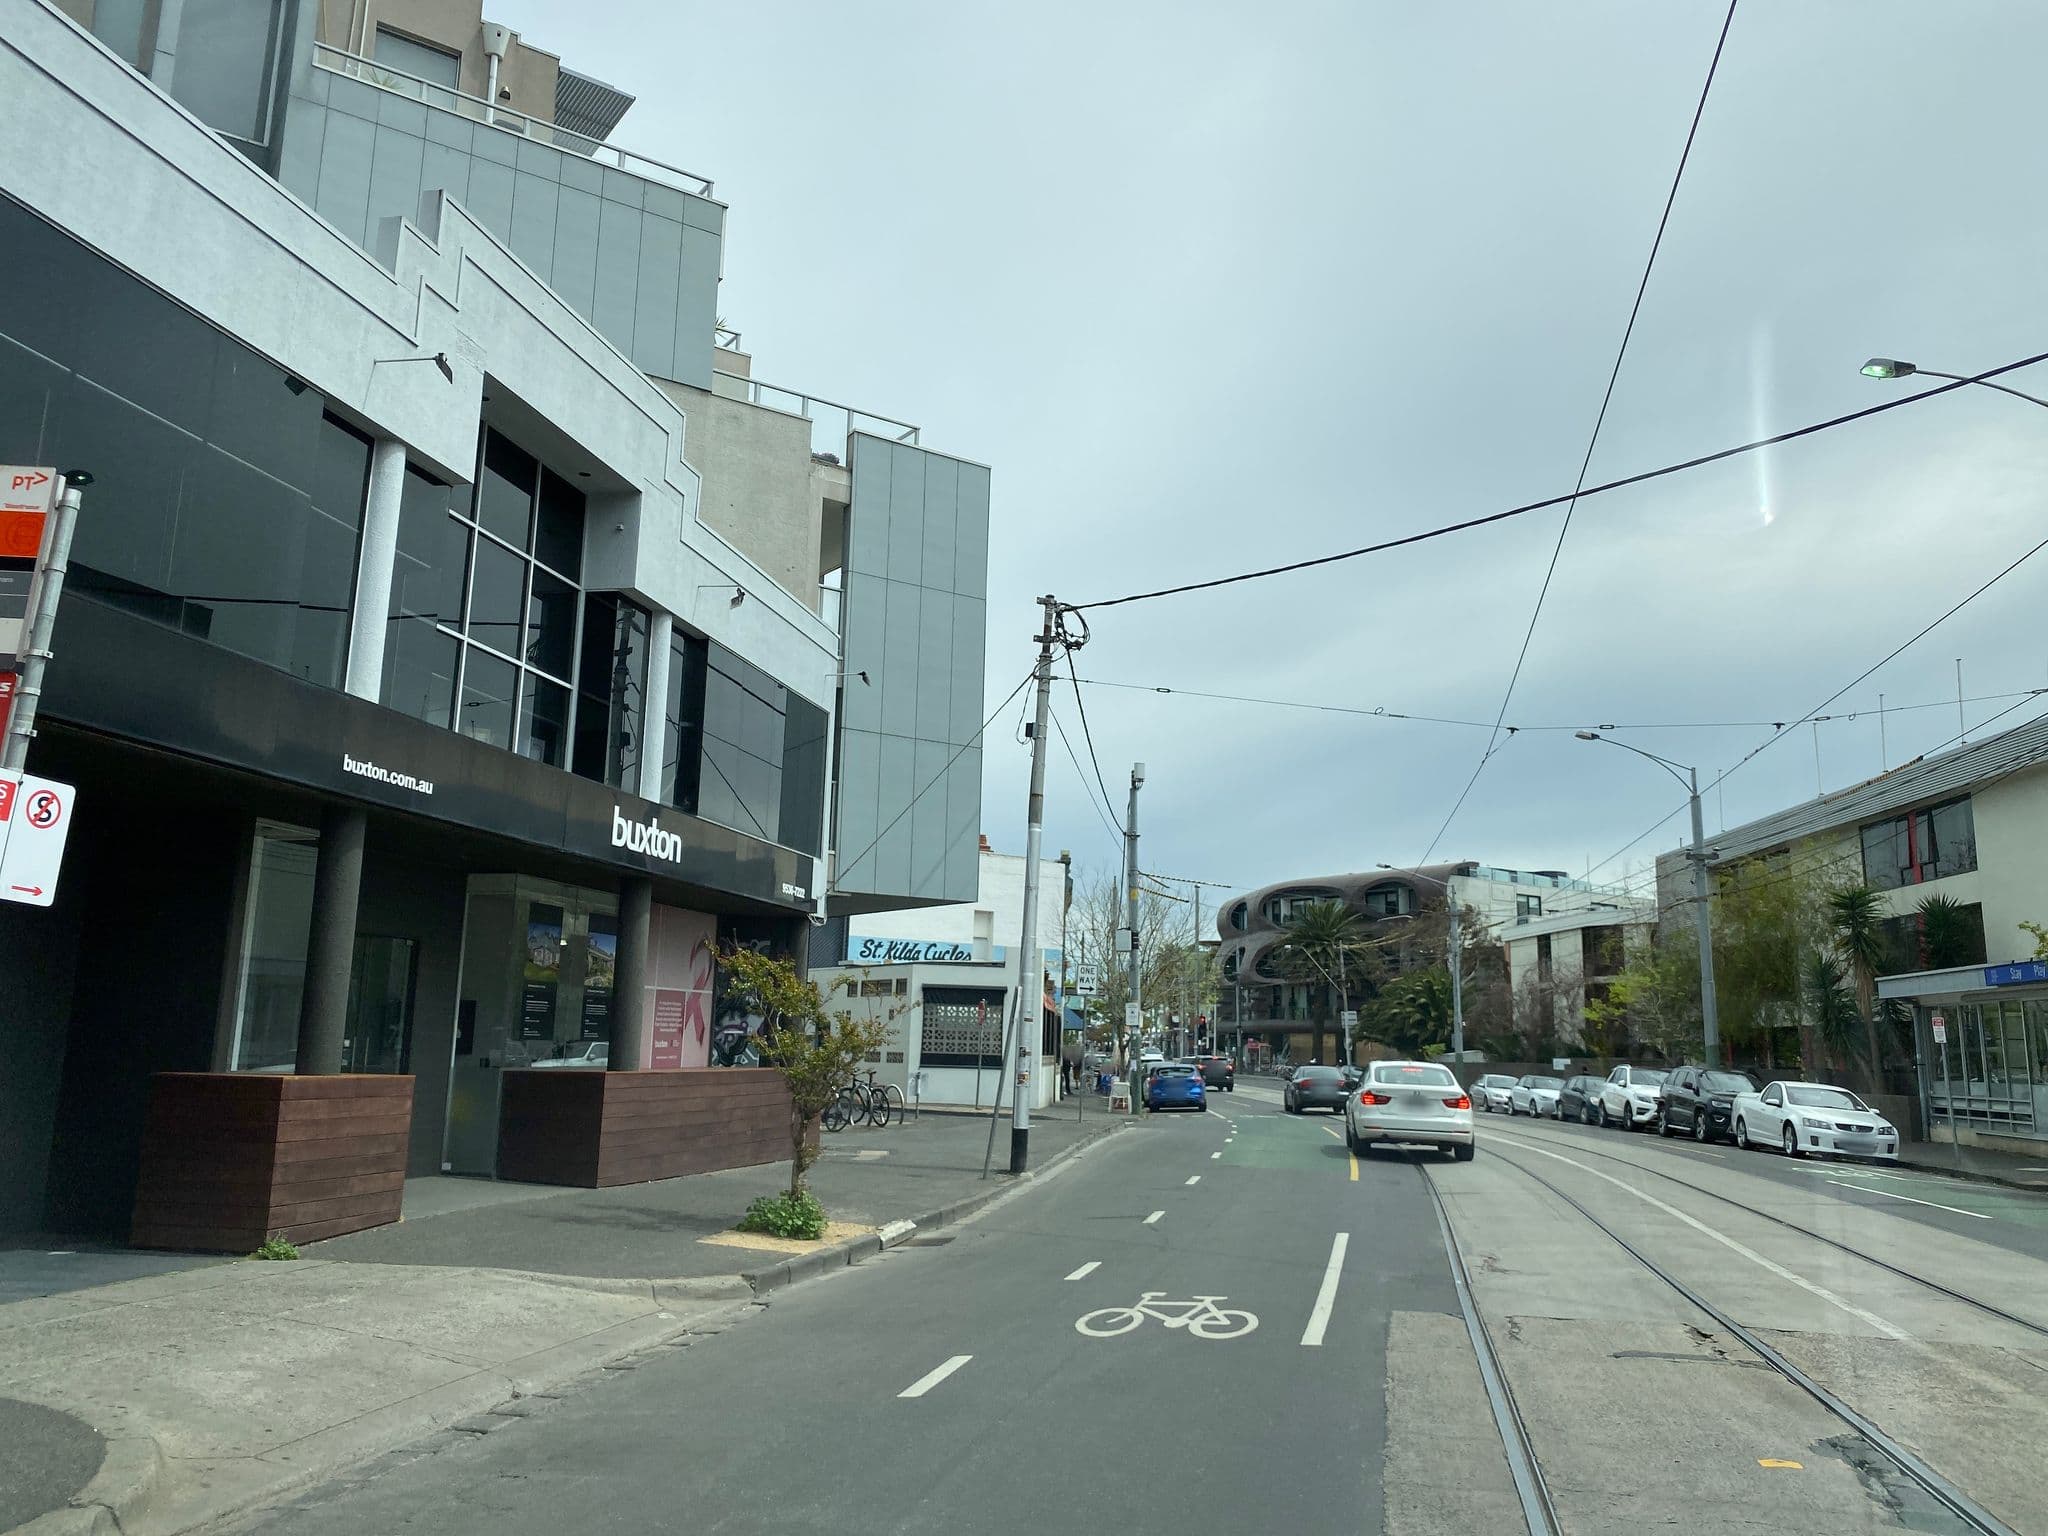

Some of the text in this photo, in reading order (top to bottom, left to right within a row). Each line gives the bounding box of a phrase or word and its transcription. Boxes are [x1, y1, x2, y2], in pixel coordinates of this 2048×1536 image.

[343, 753, 434, 794] buxton.com.au
[611, 805, 682, 864] buxton
[859, 939, 972, 961] St. Kilda Cycles
[1080, 966, 1096, 975] ONE
[1080, 976, 1096, 985] WAY
